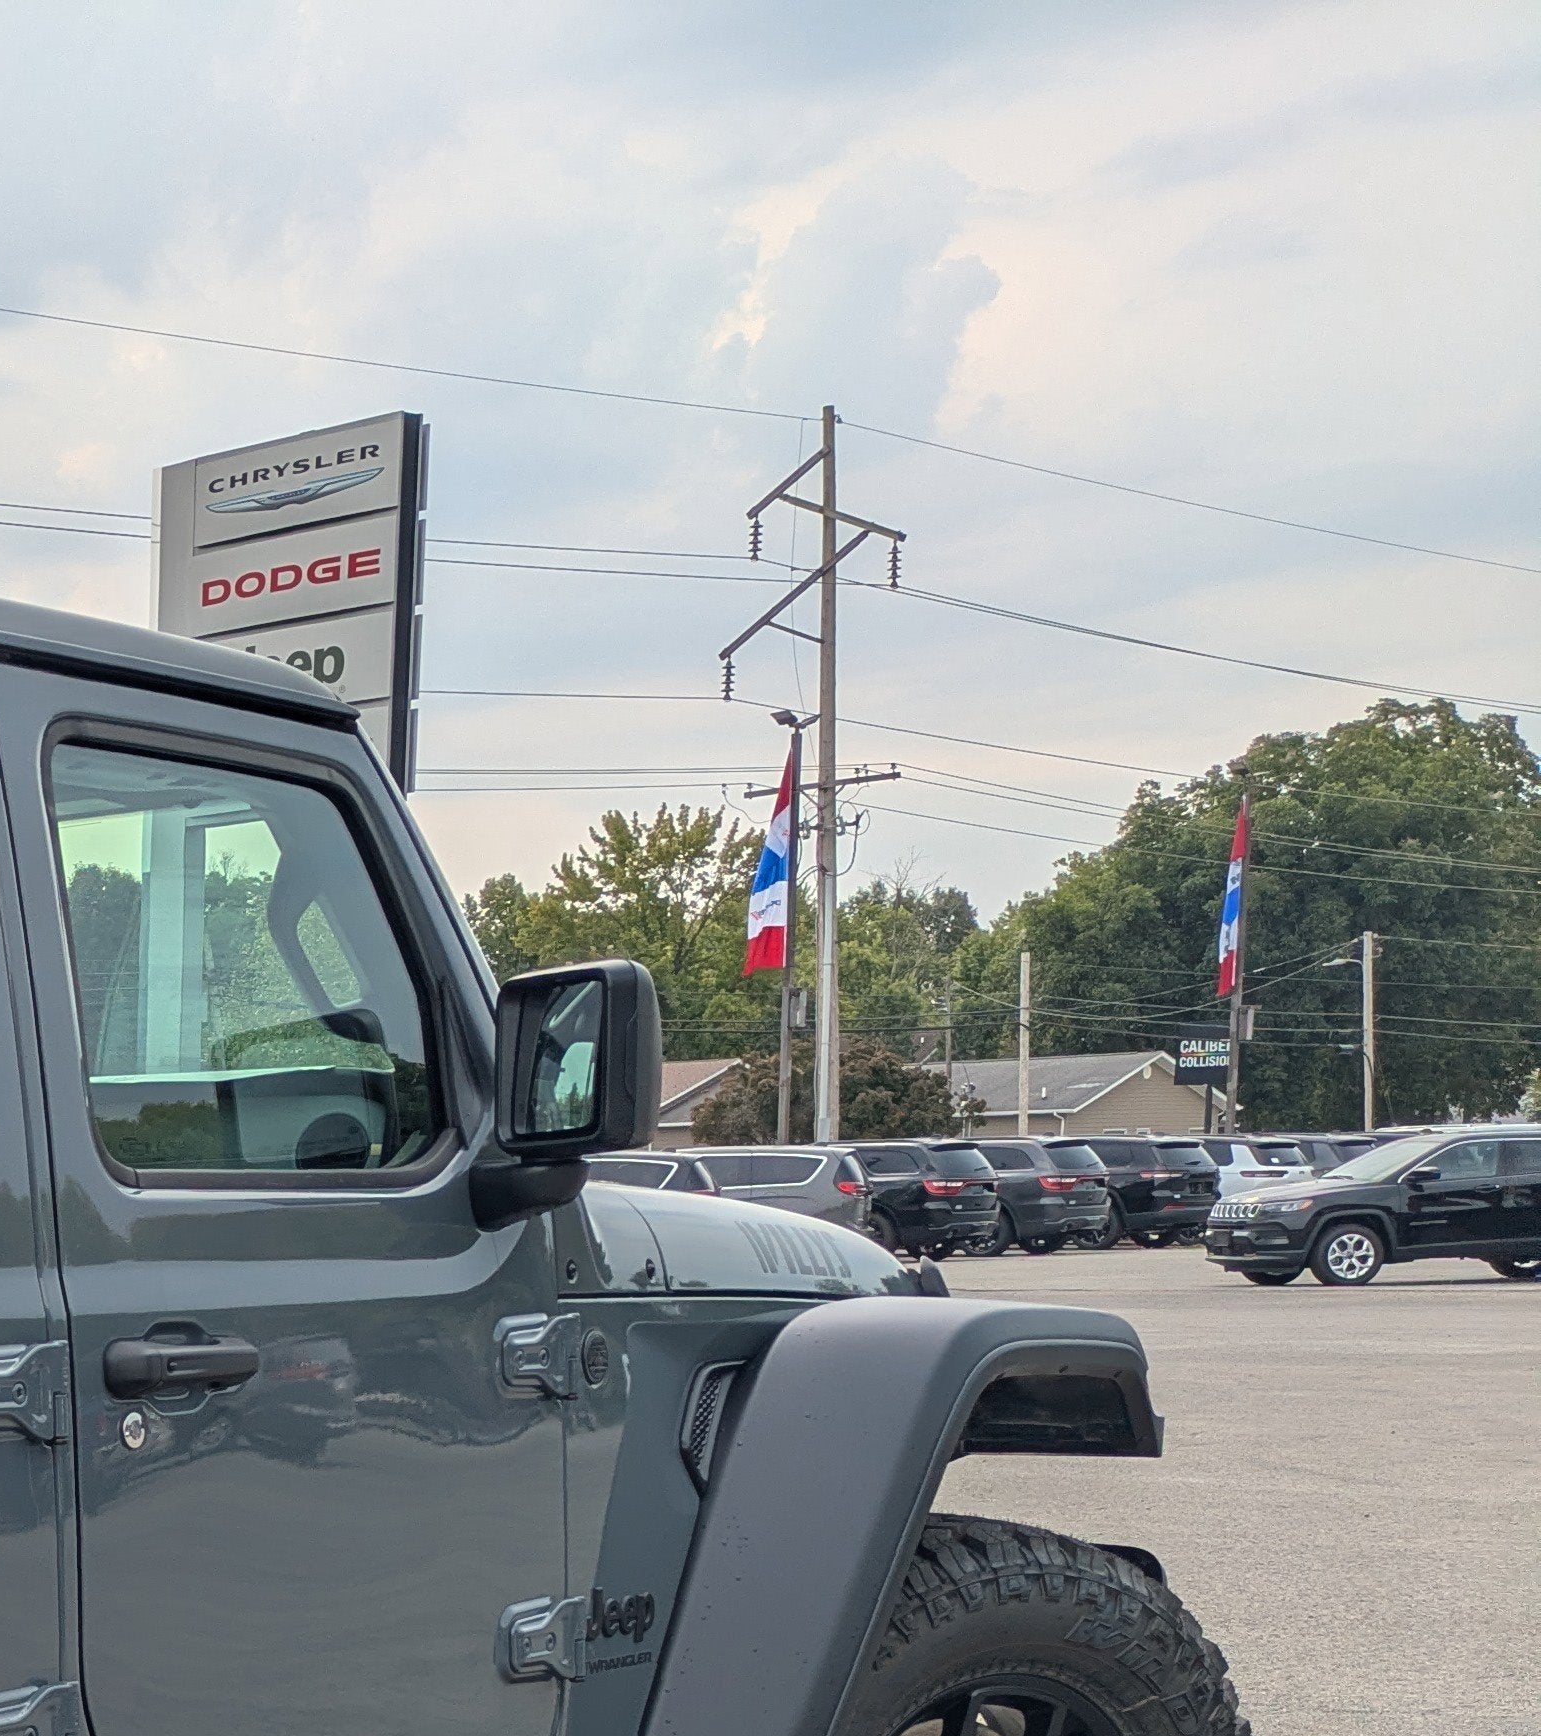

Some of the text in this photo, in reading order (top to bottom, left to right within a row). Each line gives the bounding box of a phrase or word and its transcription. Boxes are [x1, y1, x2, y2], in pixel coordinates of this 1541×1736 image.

[207, 443, 381, 494] CHRYSLER
[201, 548, 382, 608] DODGE
[733, 1220, 852, 1279] WILLYS
[585, 1586, 655, 1643] Jeep
[585, 1652, 653, 1675] WRANGLER
